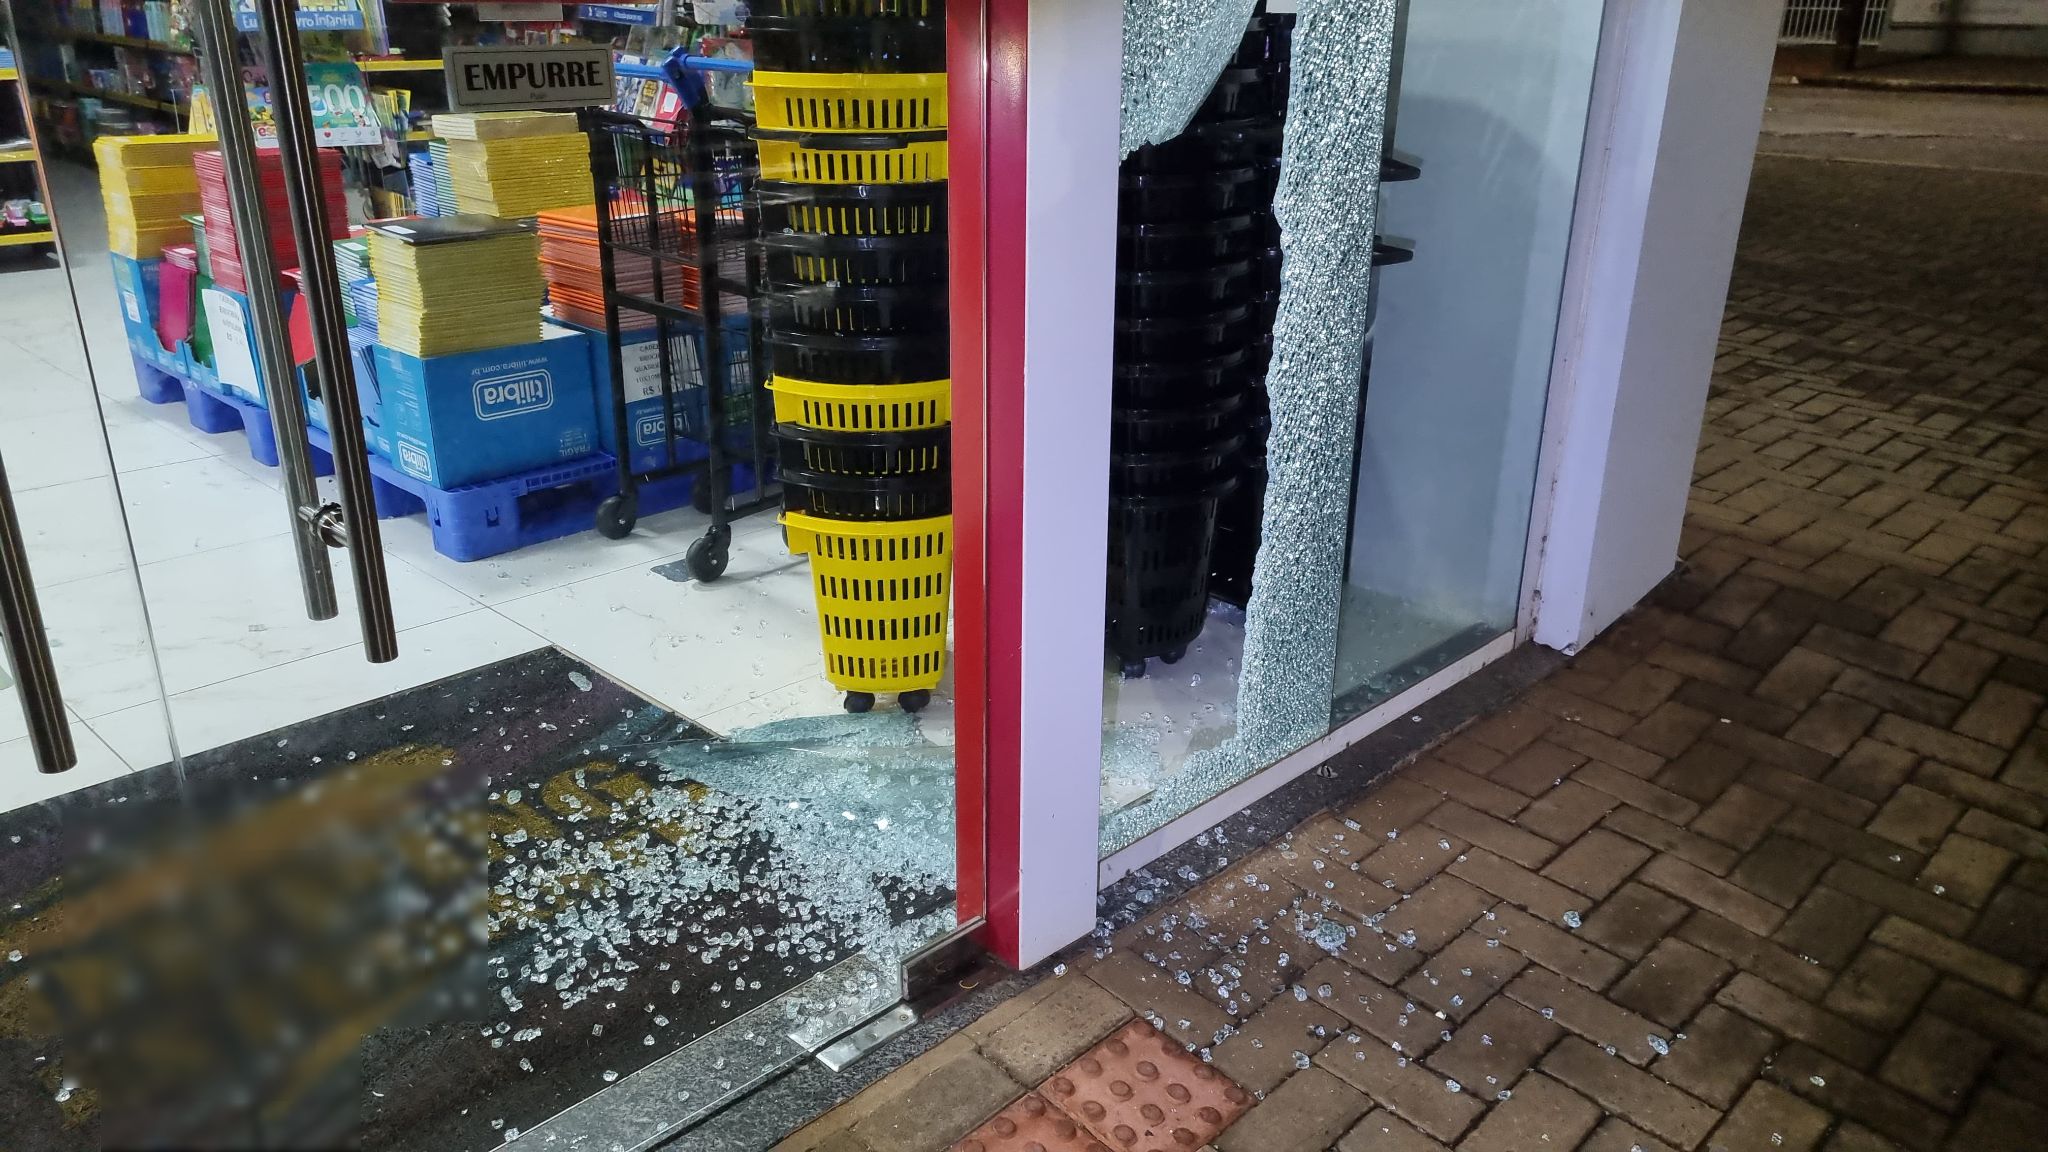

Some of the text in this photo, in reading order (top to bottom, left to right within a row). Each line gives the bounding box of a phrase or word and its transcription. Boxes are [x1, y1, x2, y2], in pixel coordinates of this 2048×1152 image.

[464, 61, 603, 91] EMPURRE
[483, 378, 544, 406] tilibra
[401, 448, 428, 473] tilibra
